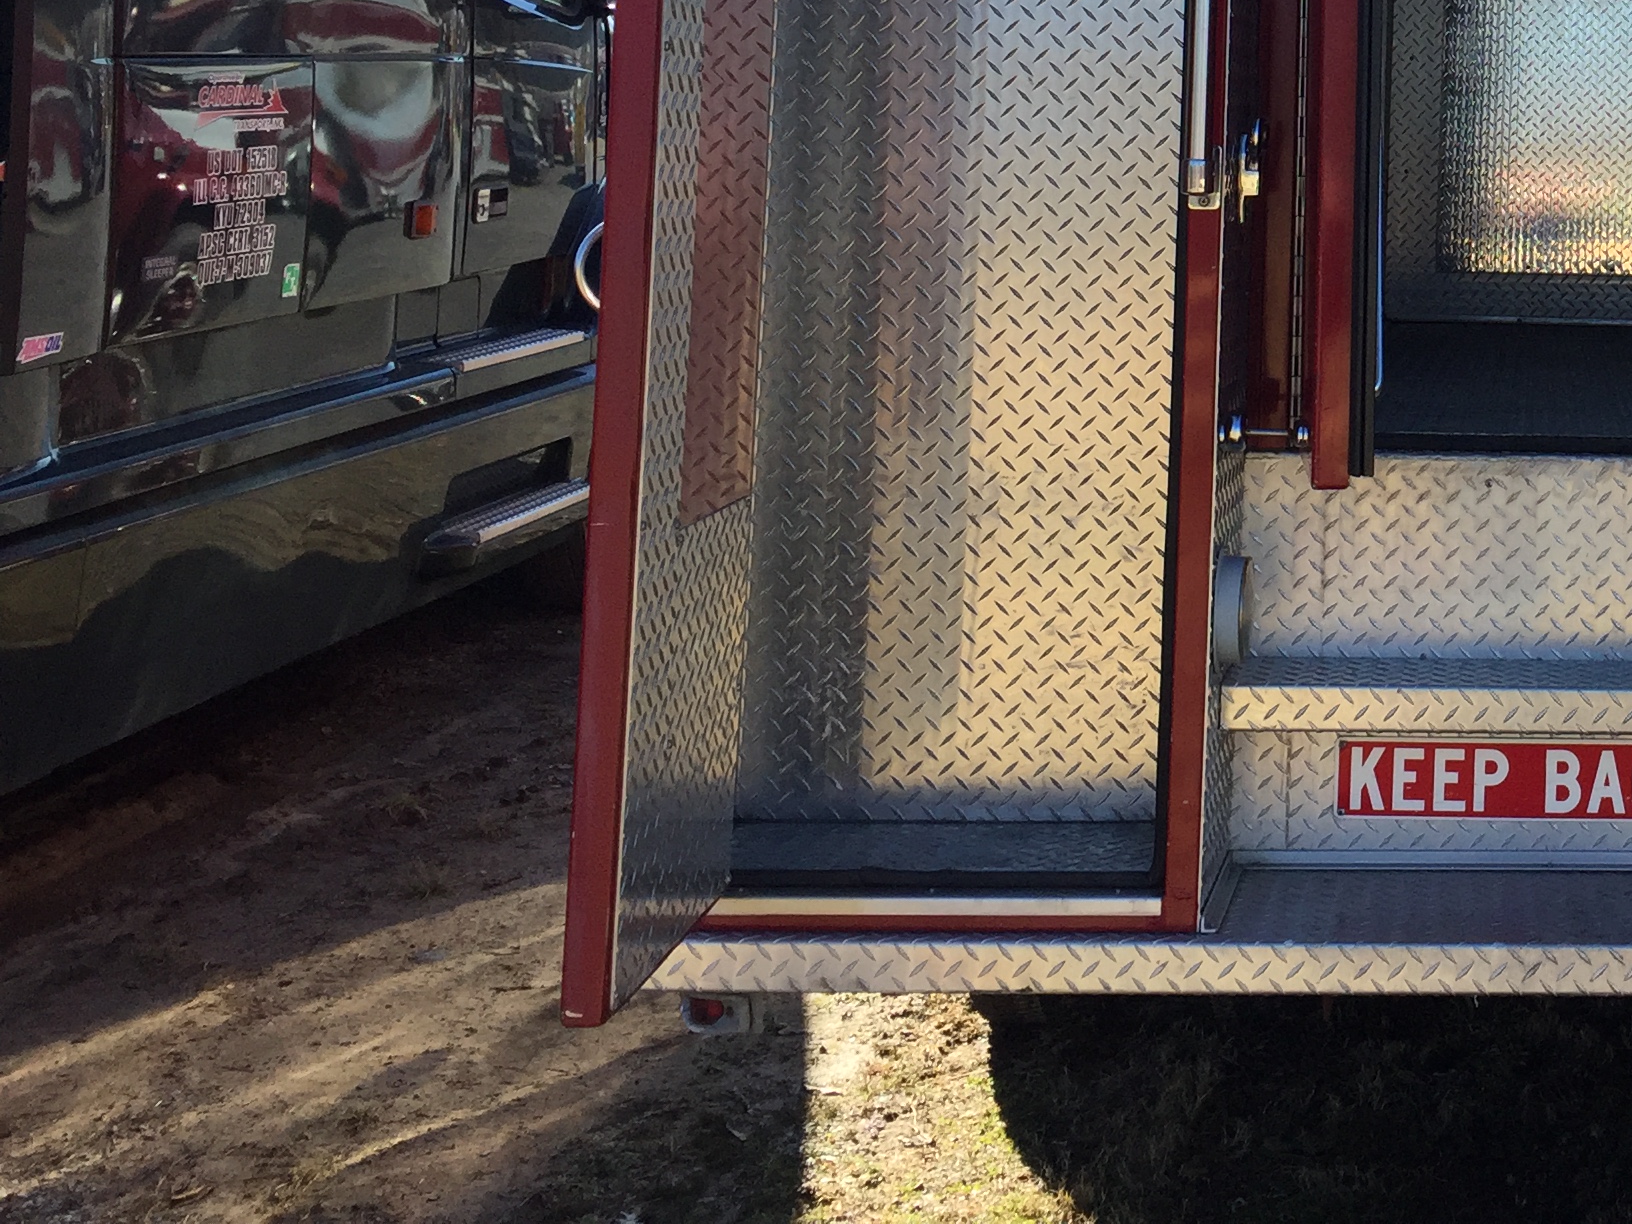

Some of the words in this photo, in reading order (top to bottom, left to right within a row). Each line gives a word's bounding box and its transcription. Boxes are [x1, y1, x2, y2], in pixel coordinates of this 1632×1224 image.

[198, 84, 264, 108] CARDINAL
[207, 150, 222, 176] US
[223, 148, 244, 174] DOT
[246, 145, 278, 172] 152518
[231, 173, 262, 200] 43360
[234, 199, 266, 227] 72904
[197, 231, 225, 259] APSC
[252, 224, 276, 250] 3152
[1348, 746, 1510, 812] KEEP
